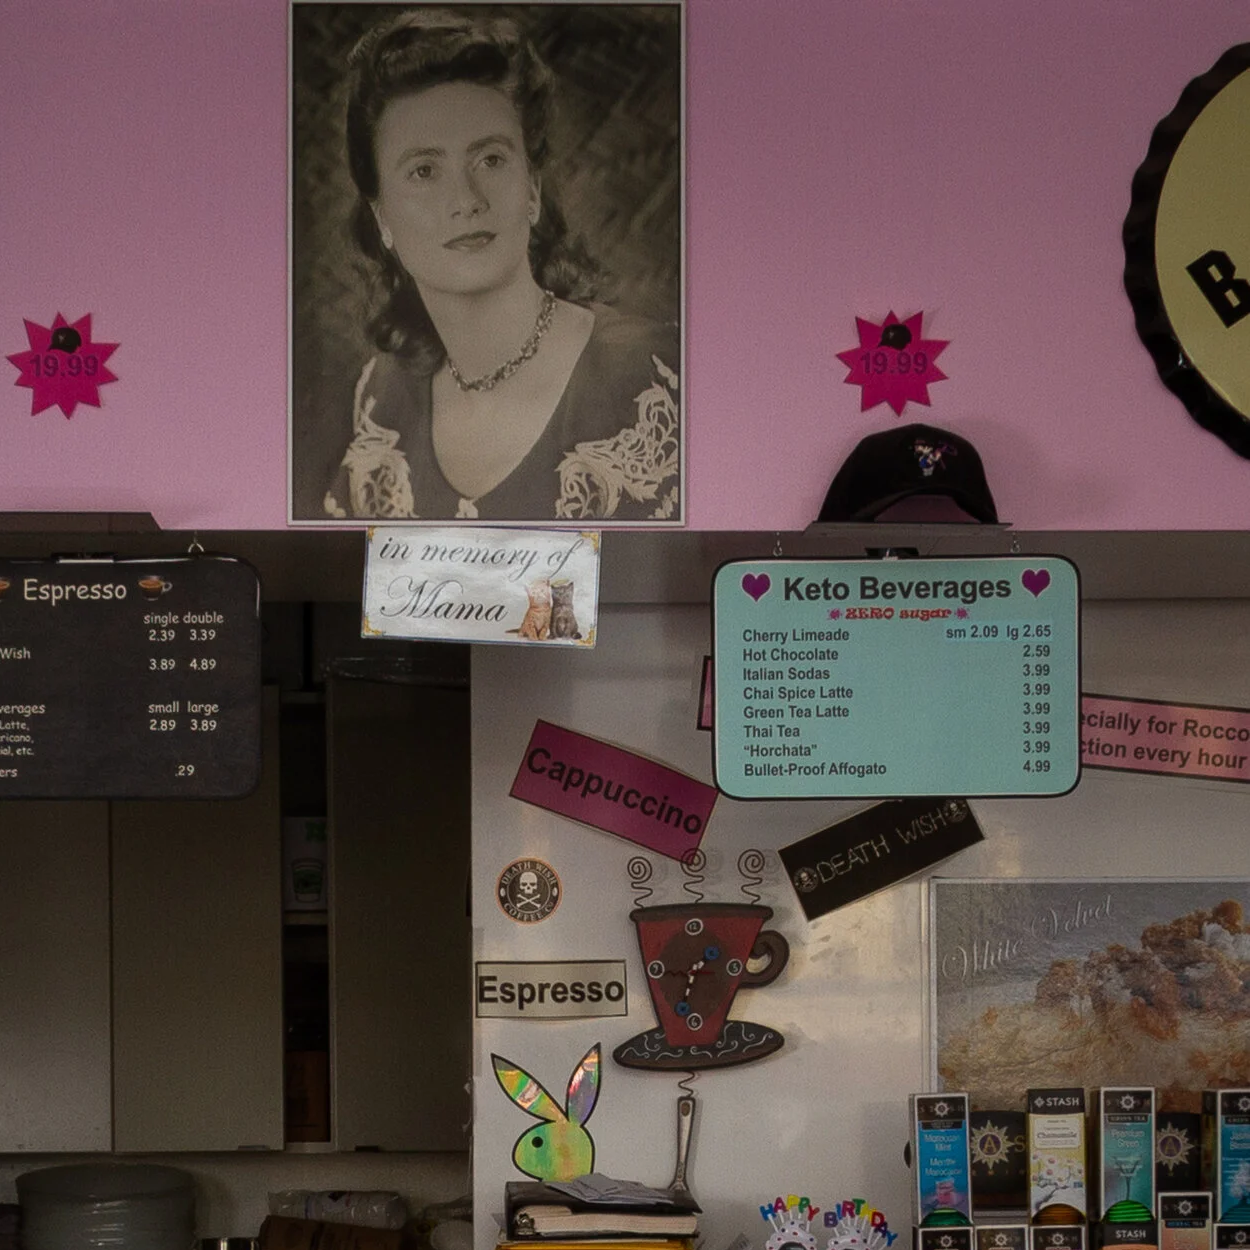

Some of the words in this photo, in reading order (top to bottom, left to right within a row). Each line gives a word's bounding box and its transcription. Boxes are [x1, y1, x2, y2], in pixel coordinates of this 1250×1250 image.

[30, 355, 98, 377] 19.99
[858, 350, 928, 377] 19.99
[379, 537, 409, 560] in
[421, 546, 540, 581] memory
[547, 539, 584, 579] of
[23, 578, 127, 606] Espresso
[784, 577, 850, 601] Keto
[860, 576, 1012, 604] Beverages
[380, 575, 508, 622] Mama
[144, 612, 179, 626] single
[183, 612, 224, 624] double
[845, 608, 895, 619] ZERO
[899, 609, 952, 621] sugar
[743, 629, 788, 645] Cherry
[792, 629, 850, 642] Limeade
[946, 628, 966, 639] sm
[970, 626, 999, 638] 2.09
[1006, 625, 1019, 640] lg
[1023, 625, 1051, 637] 2.65
[0, 648, 31, 660] Wish
[743, 649, 766, 661] Hot
[770, 649, 839, 661] Chocolate
[743, 668, 784, 681] Italian
[787, 667, 830, 680] Sodas
[743, 686, 774, 700] Chai
[778, 686, 816, 703] Spice
[820, 686, 853, 699] Latte
[149, 702, 180, 713] small
[187, 701, 219, 715] large
[743, 706, 785, 719] Green
[788, 706, 812, 719] Tea
[816, 705, 850, 718] Latte
[743, 725, 773, 738] Thai
[776, 725, 800, 738] Tea
[1147, 716, 1177, 735] for
[1183, 719, 1250, 742] Rocco
[744, 762, 825, 776] Bullet-Proof
[828, 762, 887, 778] Affogato
[526, 748, 702, 835] Cappuccino
[816, 835, 891, 884] DEATH
[895, 808, 946, 846] WISH
[479, 976, 625, 1009] Espresso
[1046, 1097, 1079, 1107] STASH
[759, 1194, 820, 1221] HAPPY
[824, 1198, 898, 1247] BIRTHDAY
